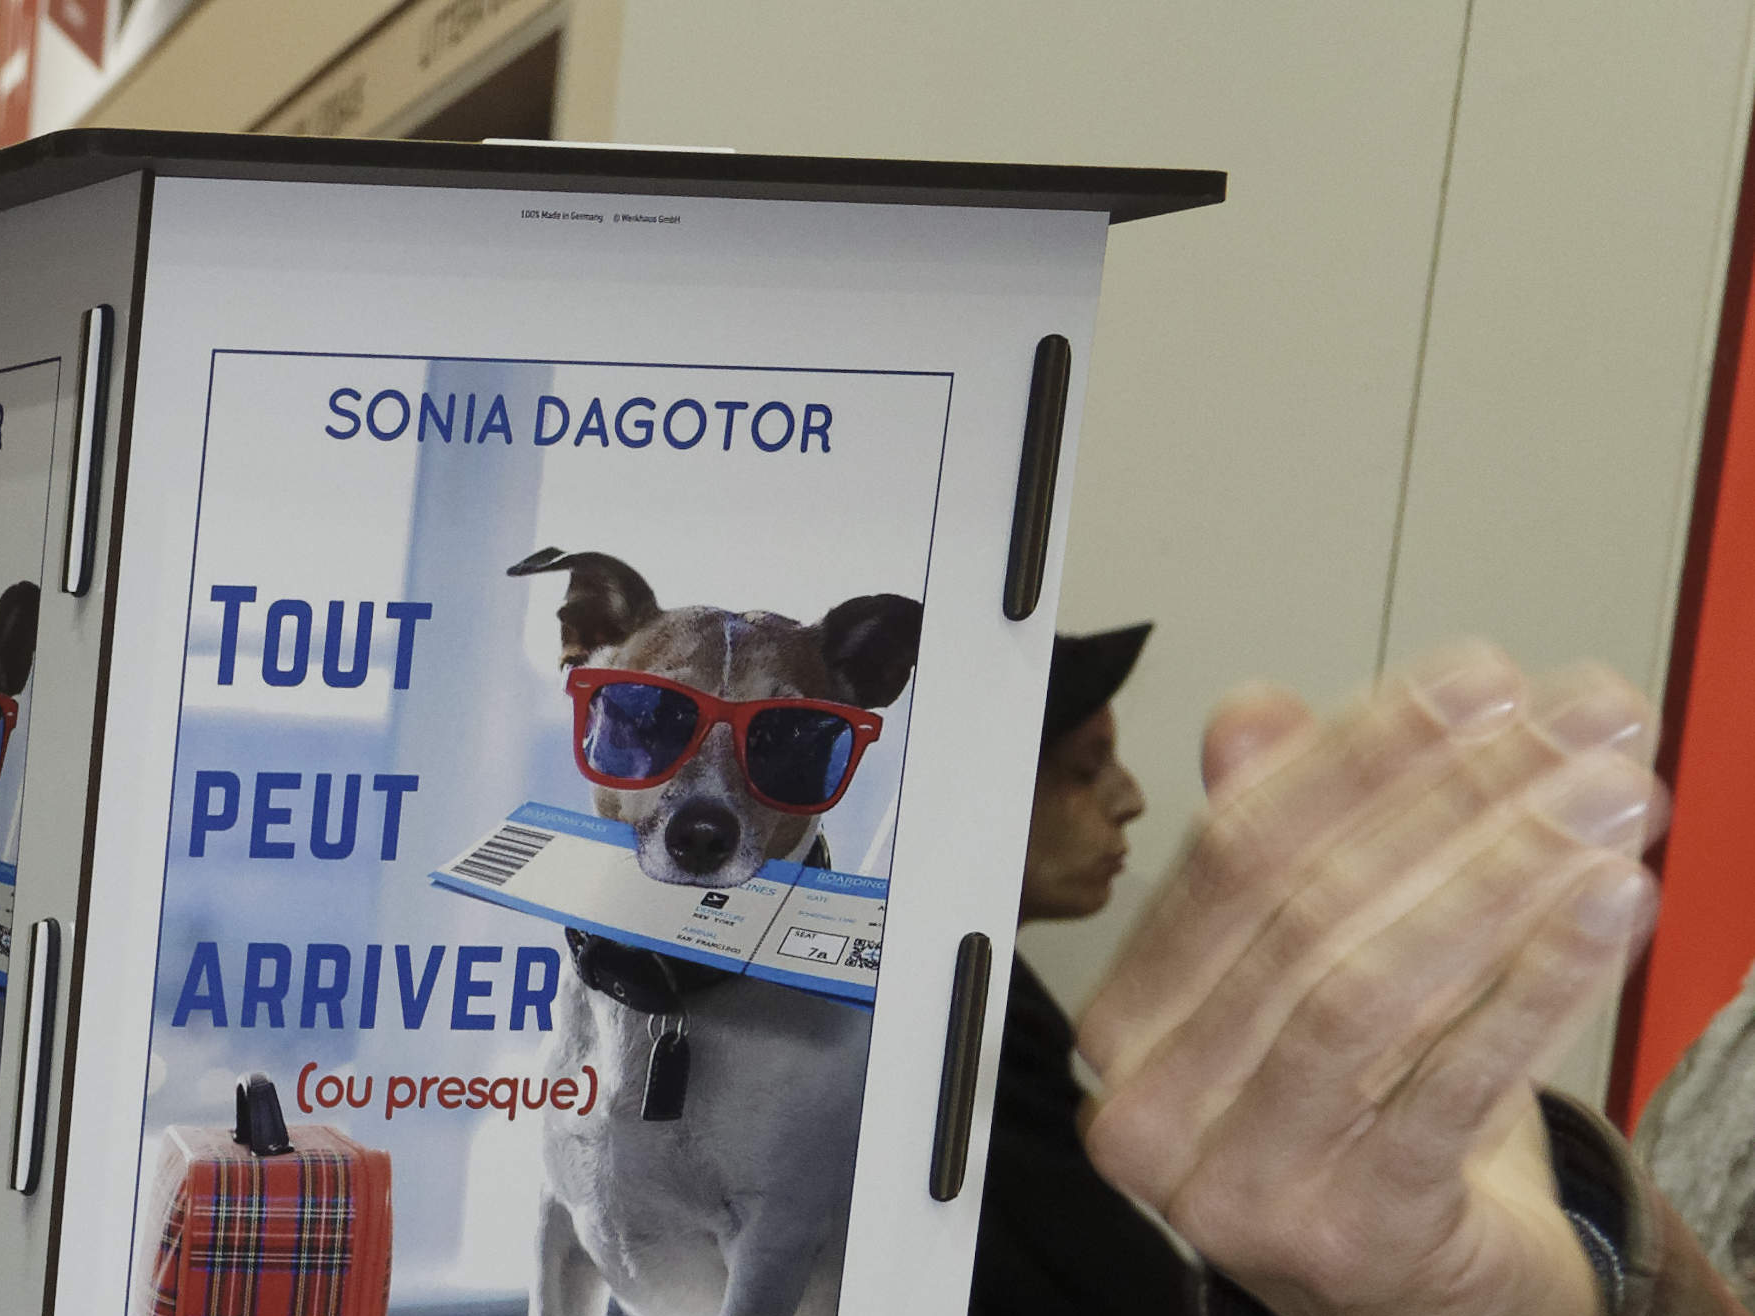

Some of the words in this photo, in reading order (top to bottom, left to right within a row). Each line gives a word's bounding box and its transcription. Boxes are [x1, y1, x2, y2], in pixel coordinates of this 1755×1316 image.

[325, 387, 513, 445] SONIA
[533, 395, 834, 454] DAGOTOR
[210, 584, 434, 690] TOUT
[188, 769, 420, 862] PEUT
[816, 871, 887, 890] BOARDING
[171, 941, 561, 1032] ARRIVER
[296, 1061, 373, 1114] (ou
[385, 1064, 599, 1121] presque)
